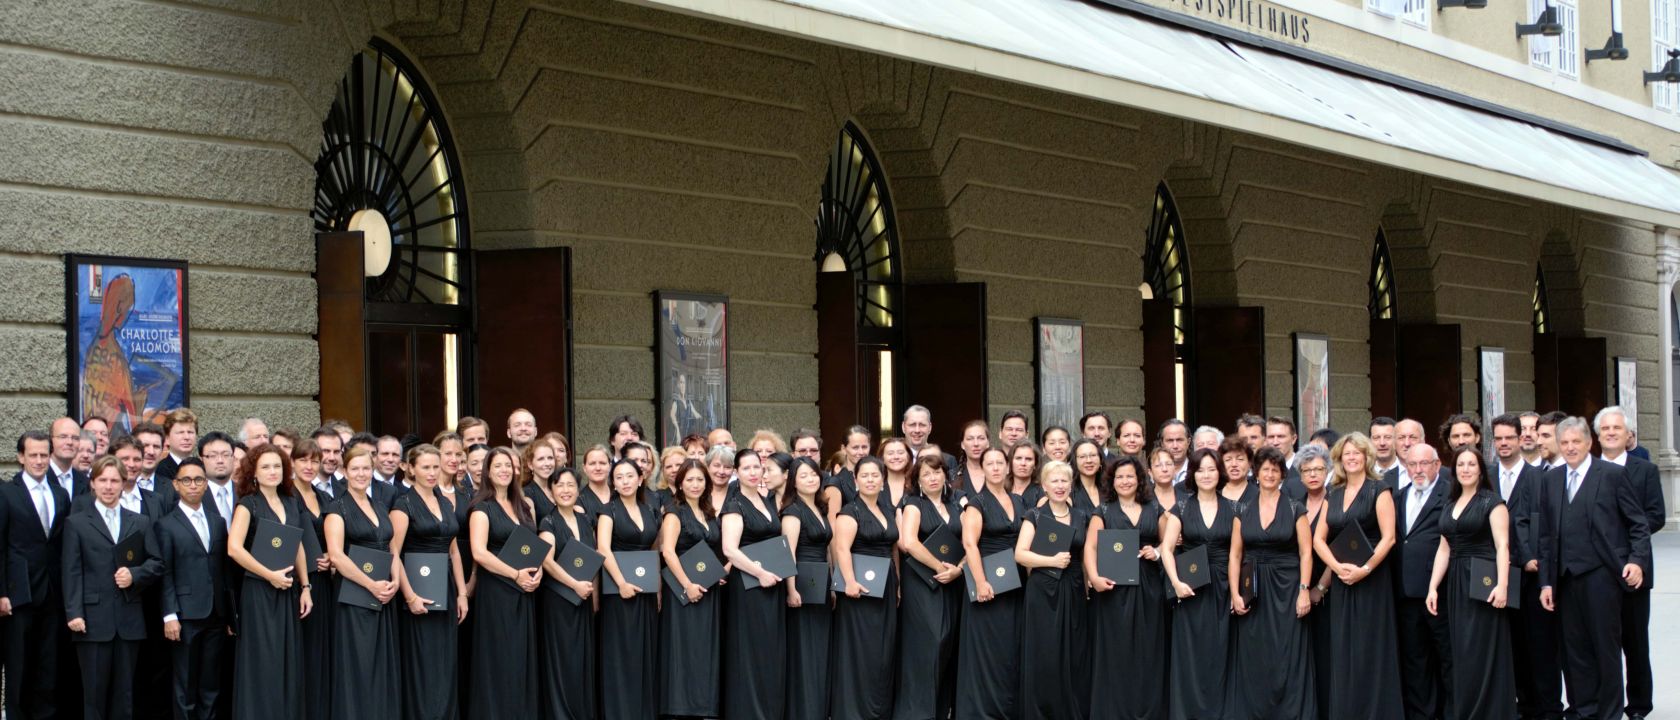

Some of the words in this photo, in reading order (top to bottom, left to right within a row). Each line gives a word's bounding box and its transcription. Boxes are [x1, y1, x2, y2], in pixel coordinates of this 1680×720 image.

[1171, 0, 1310, 43] SPIELHAUS
[121, 328, 174, 341] CHARLOTTE
[676, 336, 690, 346] DON
[131, 342, 177, 353] SALOMON
